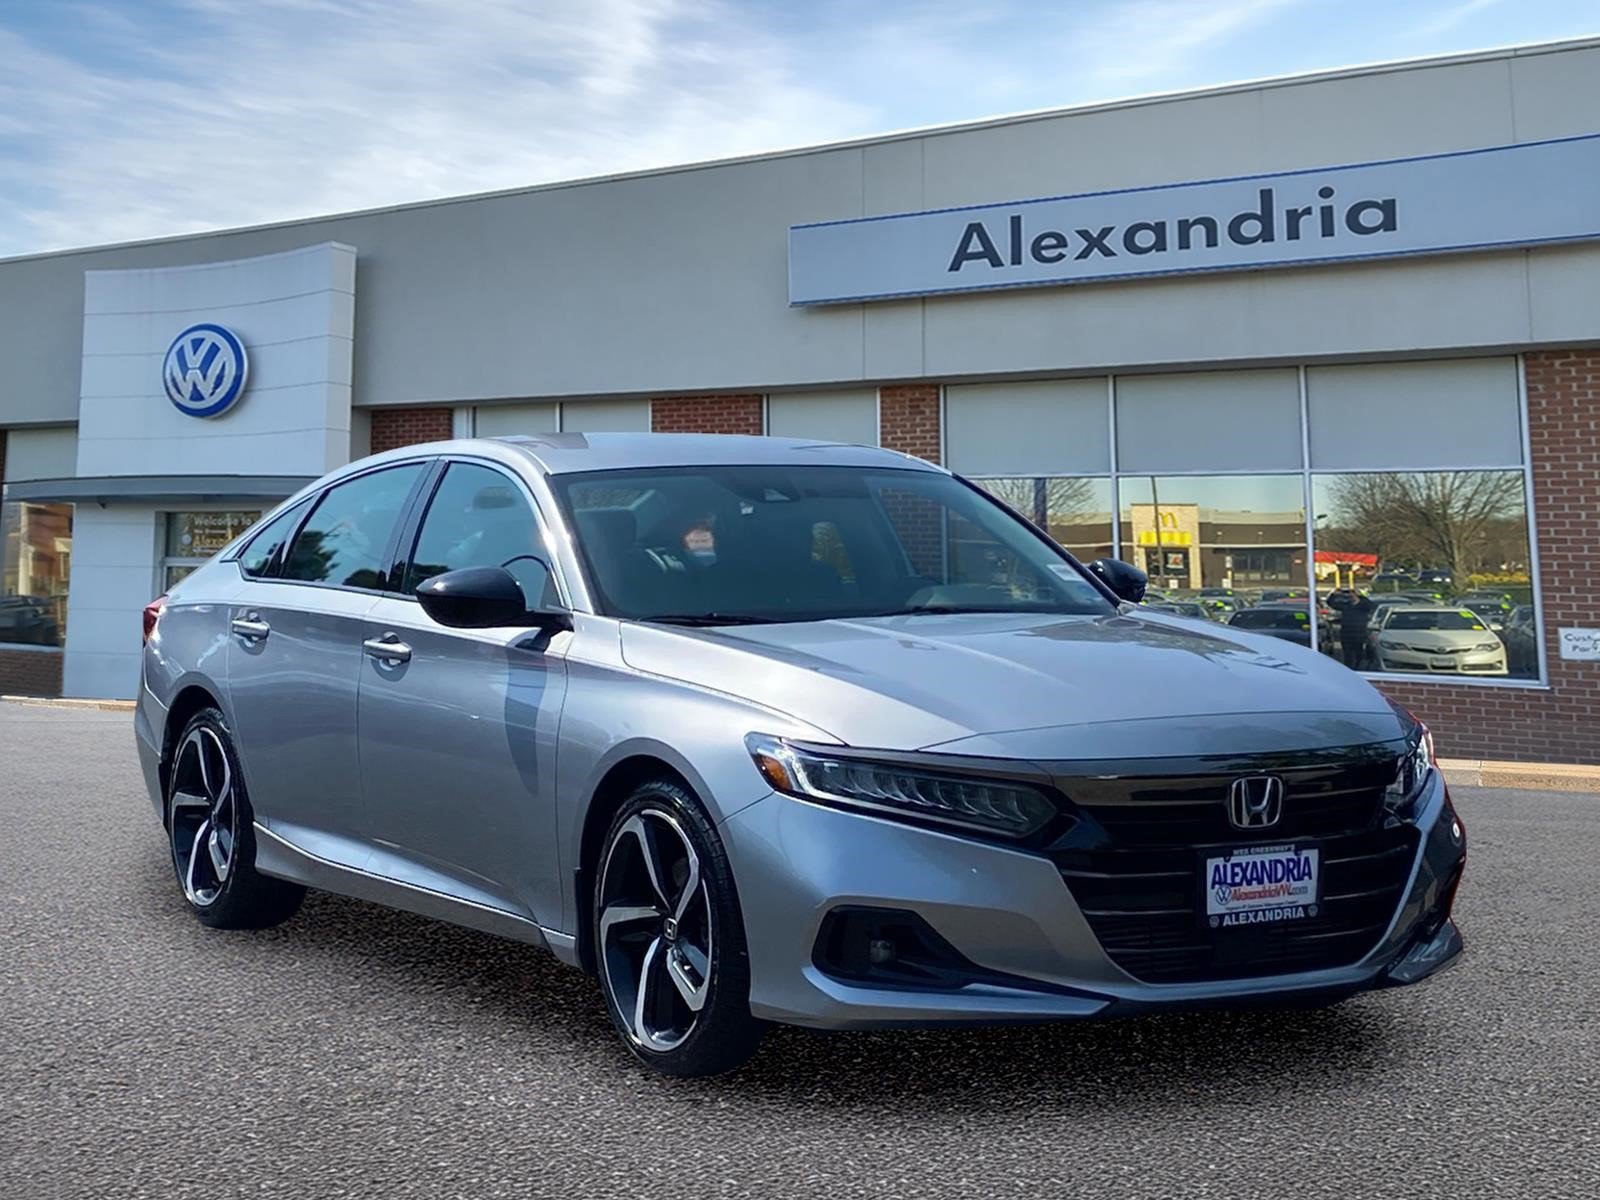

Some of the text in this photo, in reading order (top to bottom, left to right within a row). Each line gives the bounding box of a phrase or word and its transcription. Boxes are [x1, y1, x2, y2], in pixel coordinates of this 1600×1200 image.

[948, 186, 1397, 272] Alexandria
[1210, 856, 1313, 890] ALEXANDRIA
[1222, 906, 1305, 927] ALEXANDRIA
